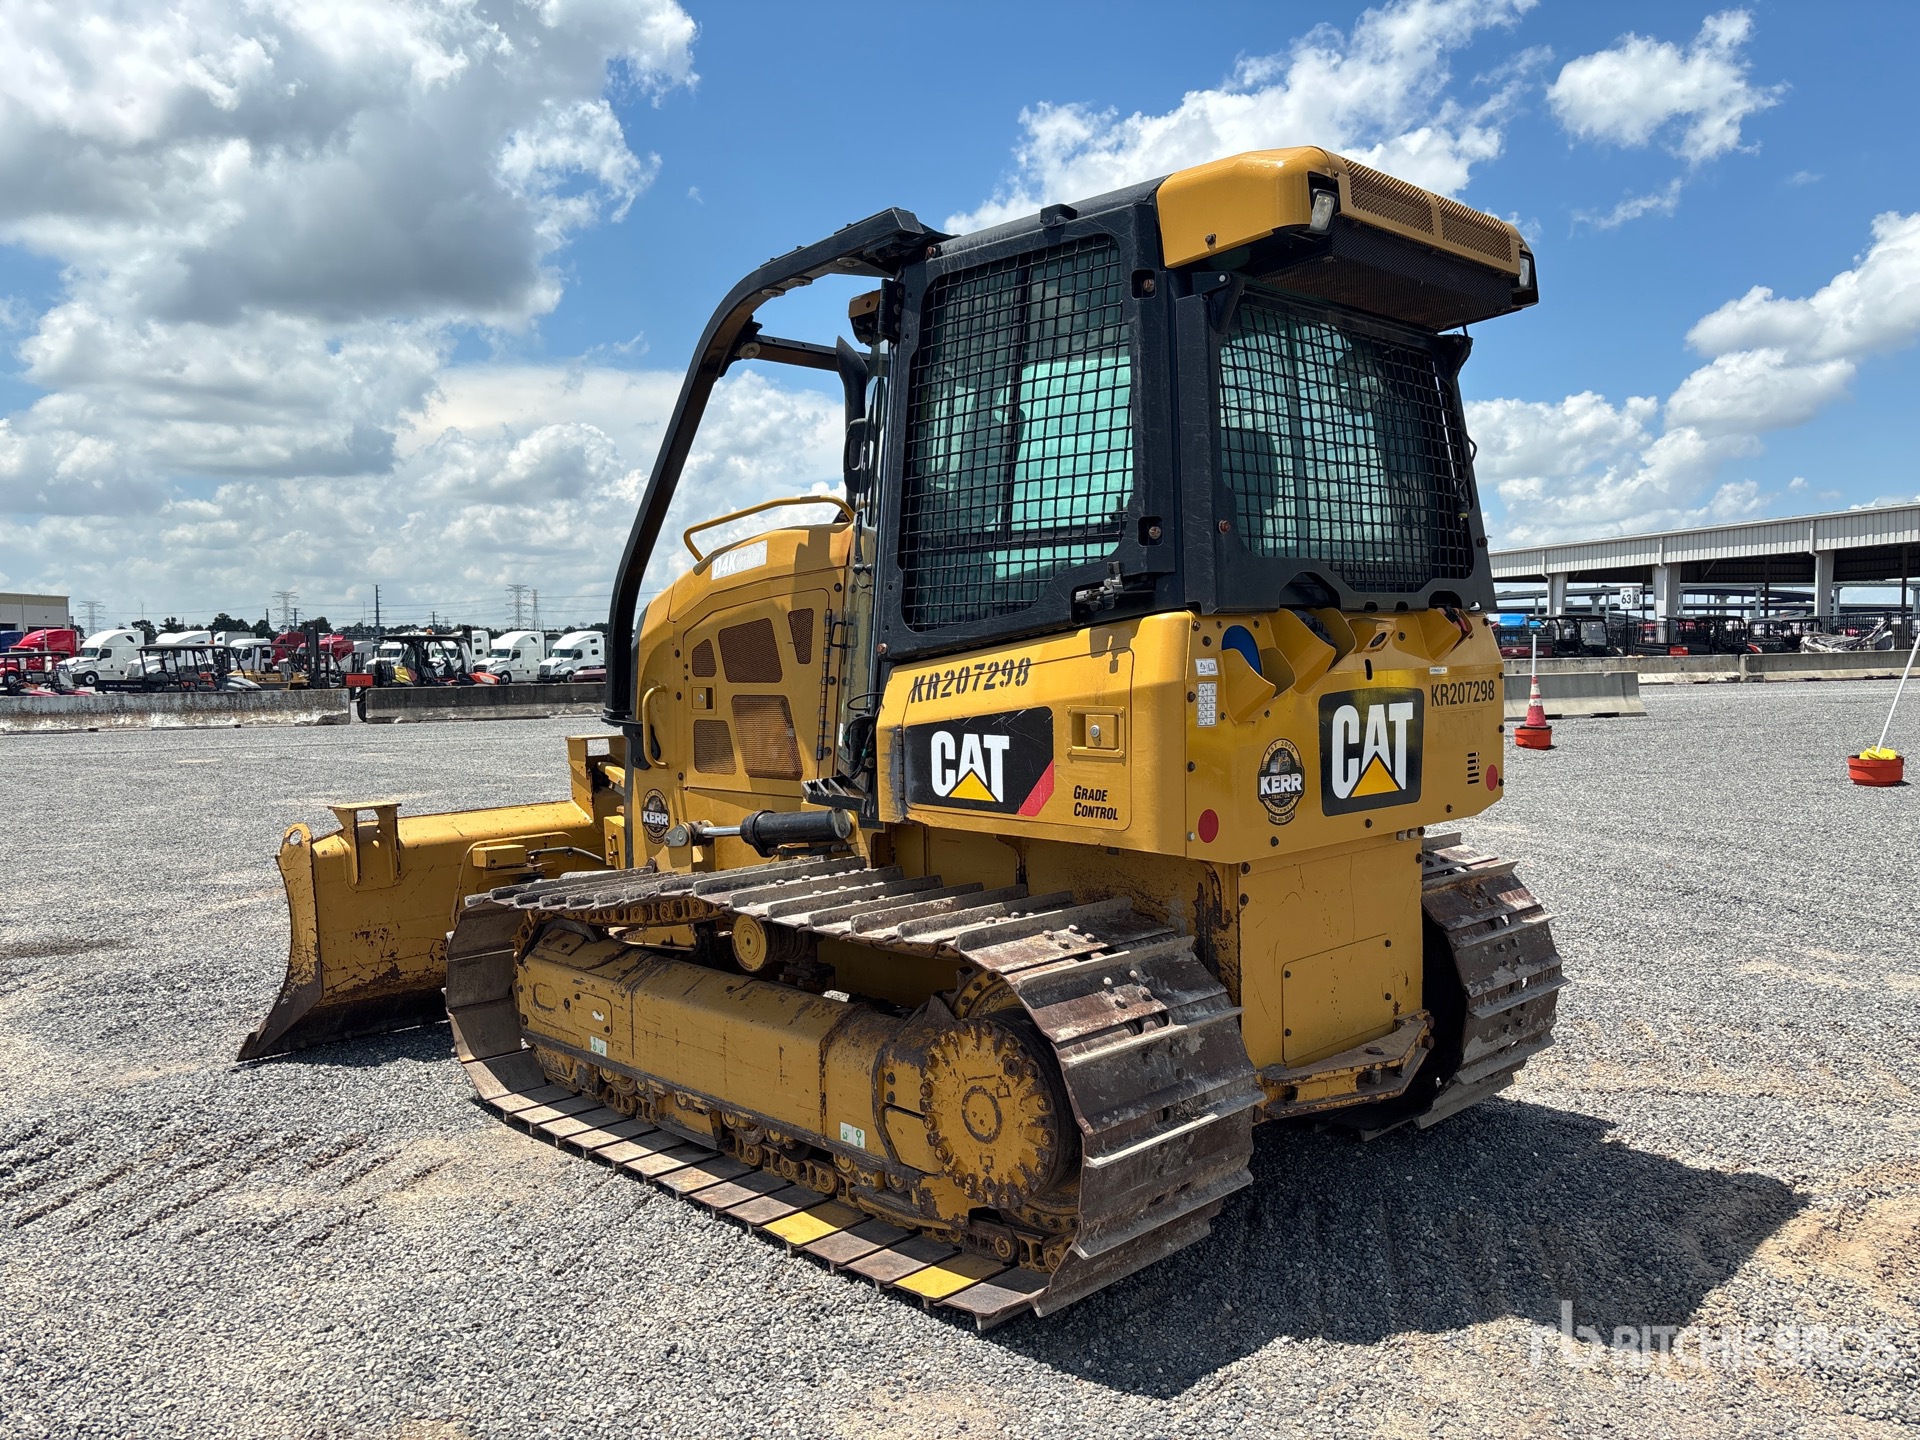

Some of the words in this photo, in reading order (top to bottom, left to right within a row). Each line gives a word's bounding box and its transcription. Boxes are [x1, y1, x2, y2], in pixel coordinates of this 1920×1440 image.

[1621, 594, 1632, 604] 63
[910, 657, 1032, 704] KR207298
[1431, 680, 1495, 707] KR207298
[1332, 702, 1414, 800] CAT
[930, 730, 1010, 803] CAT
[1073, 784, 1108, 802] GRADE
[1260, 773, 1303, 795] KERR
[642, 810, 669, 826] KERR
[1073, 802, 1119, 821] CONTROL
